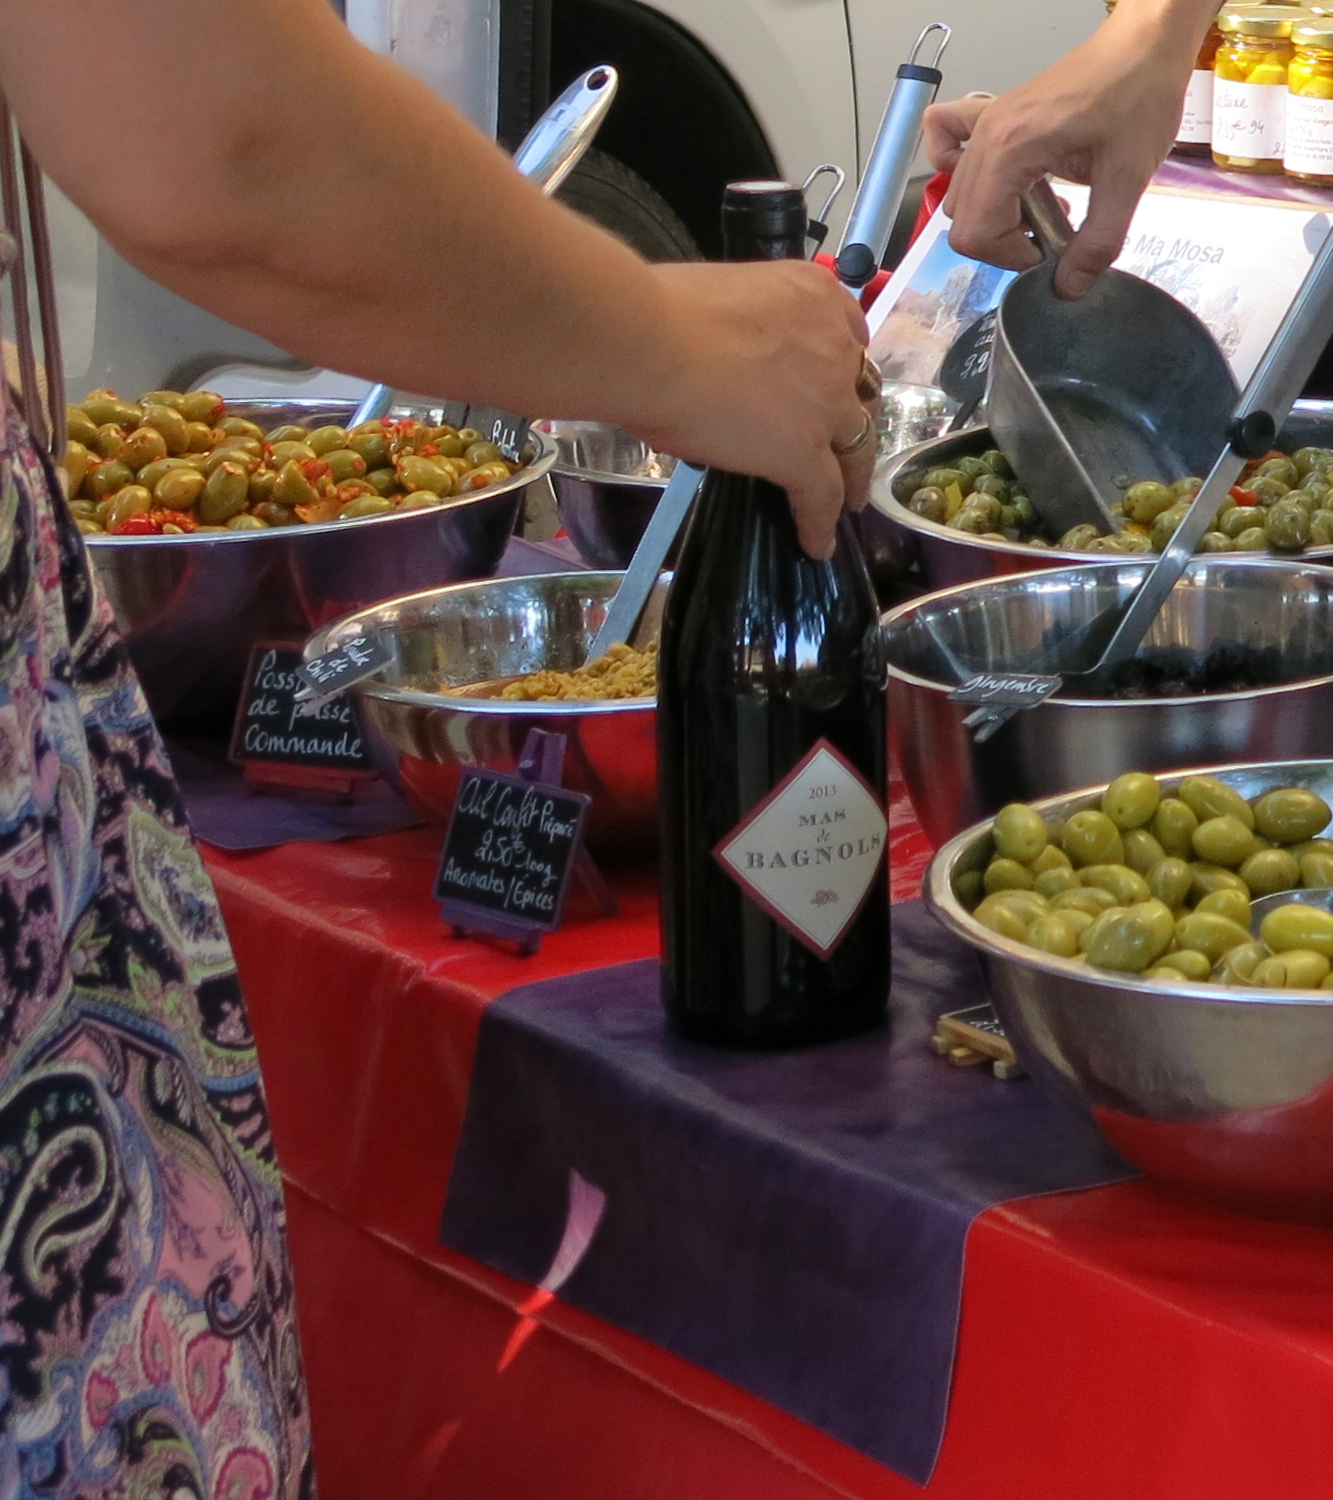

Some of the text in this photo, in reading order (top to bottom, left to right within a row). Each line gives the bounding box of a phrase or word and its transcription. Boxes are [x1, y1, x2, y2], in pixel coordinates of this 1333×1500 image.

[1134, 234, 1225, 265] Ma Mosa
[248, 694, 280, 716] de
[245, 724, 364, 759] Commande
[808, 784, 838, 800] 2013
[798, 808, 847, 828] MAS
[816, 828, 831, 843] de
[745, 831, 882, 870] BAGNOLS
